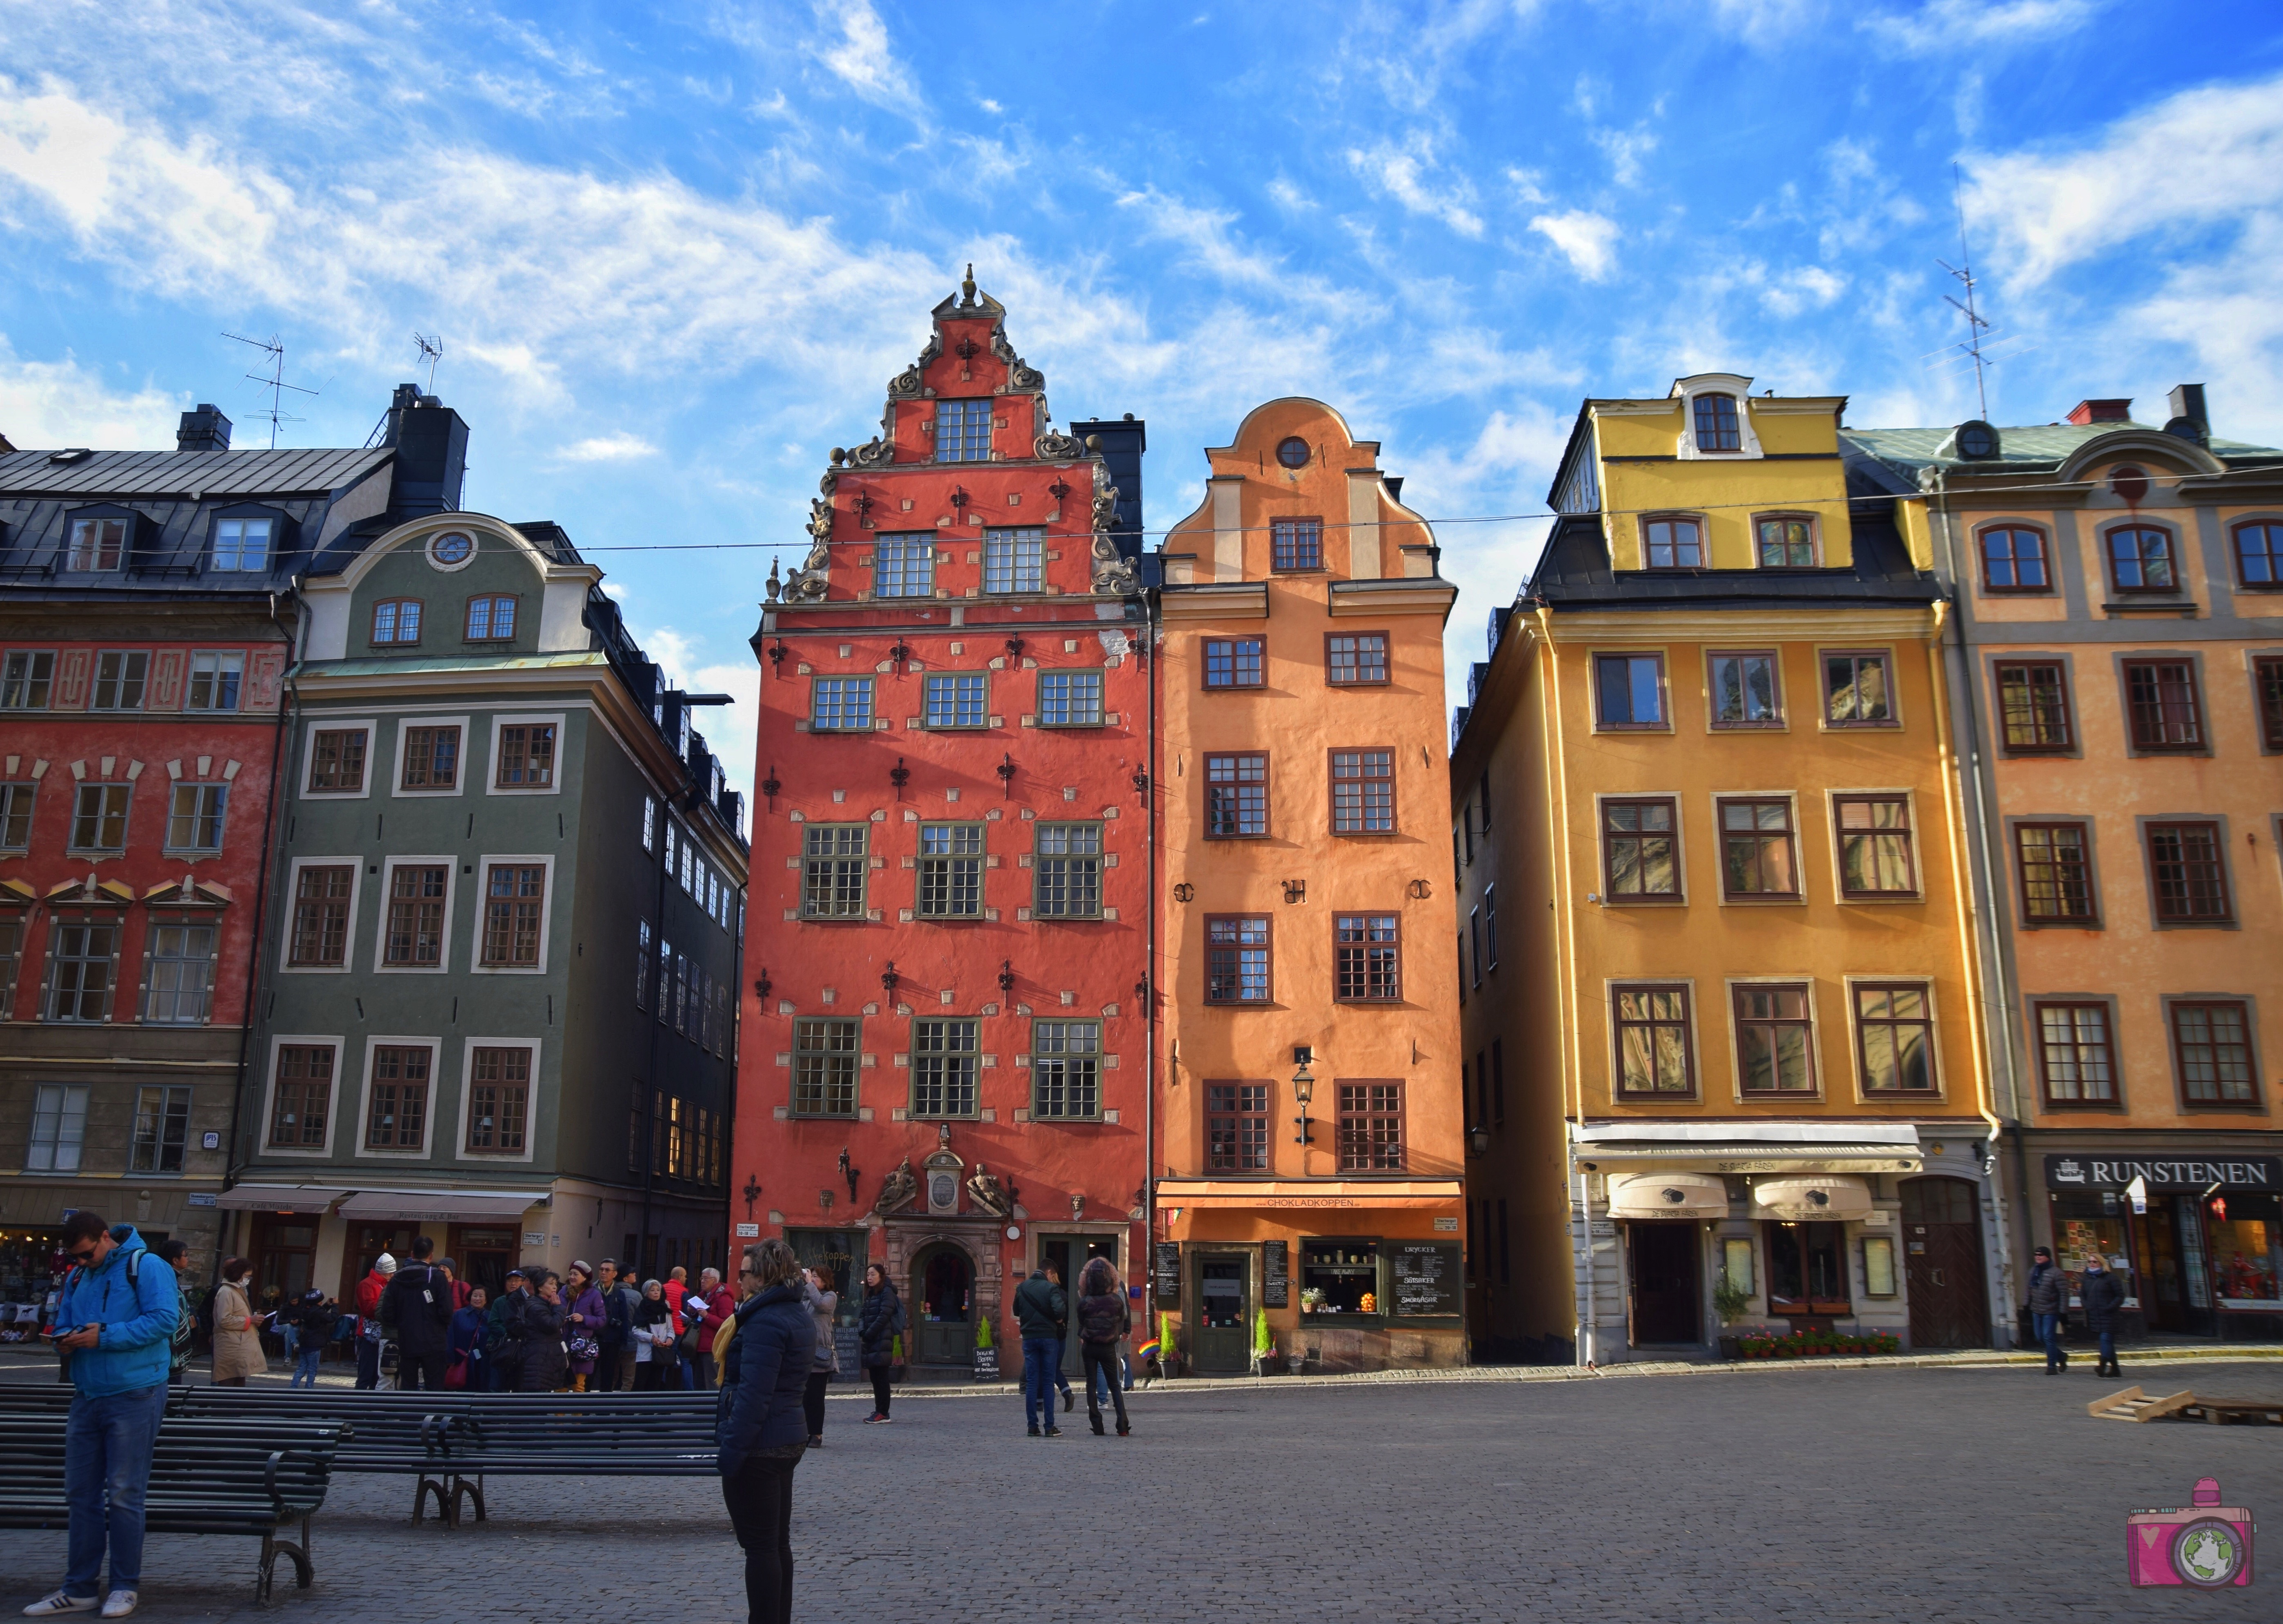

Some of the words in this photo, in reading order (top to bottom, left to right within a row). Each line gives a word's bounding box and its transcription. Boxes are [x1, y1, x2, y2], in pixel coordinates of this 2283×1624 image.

[1719, 1162, 1728, 1171] DE
[2090, 1162, 2267, 1183] RUNSTENEN
[1401, 1295, 1438, 1303] SMÖRGÅSAR
